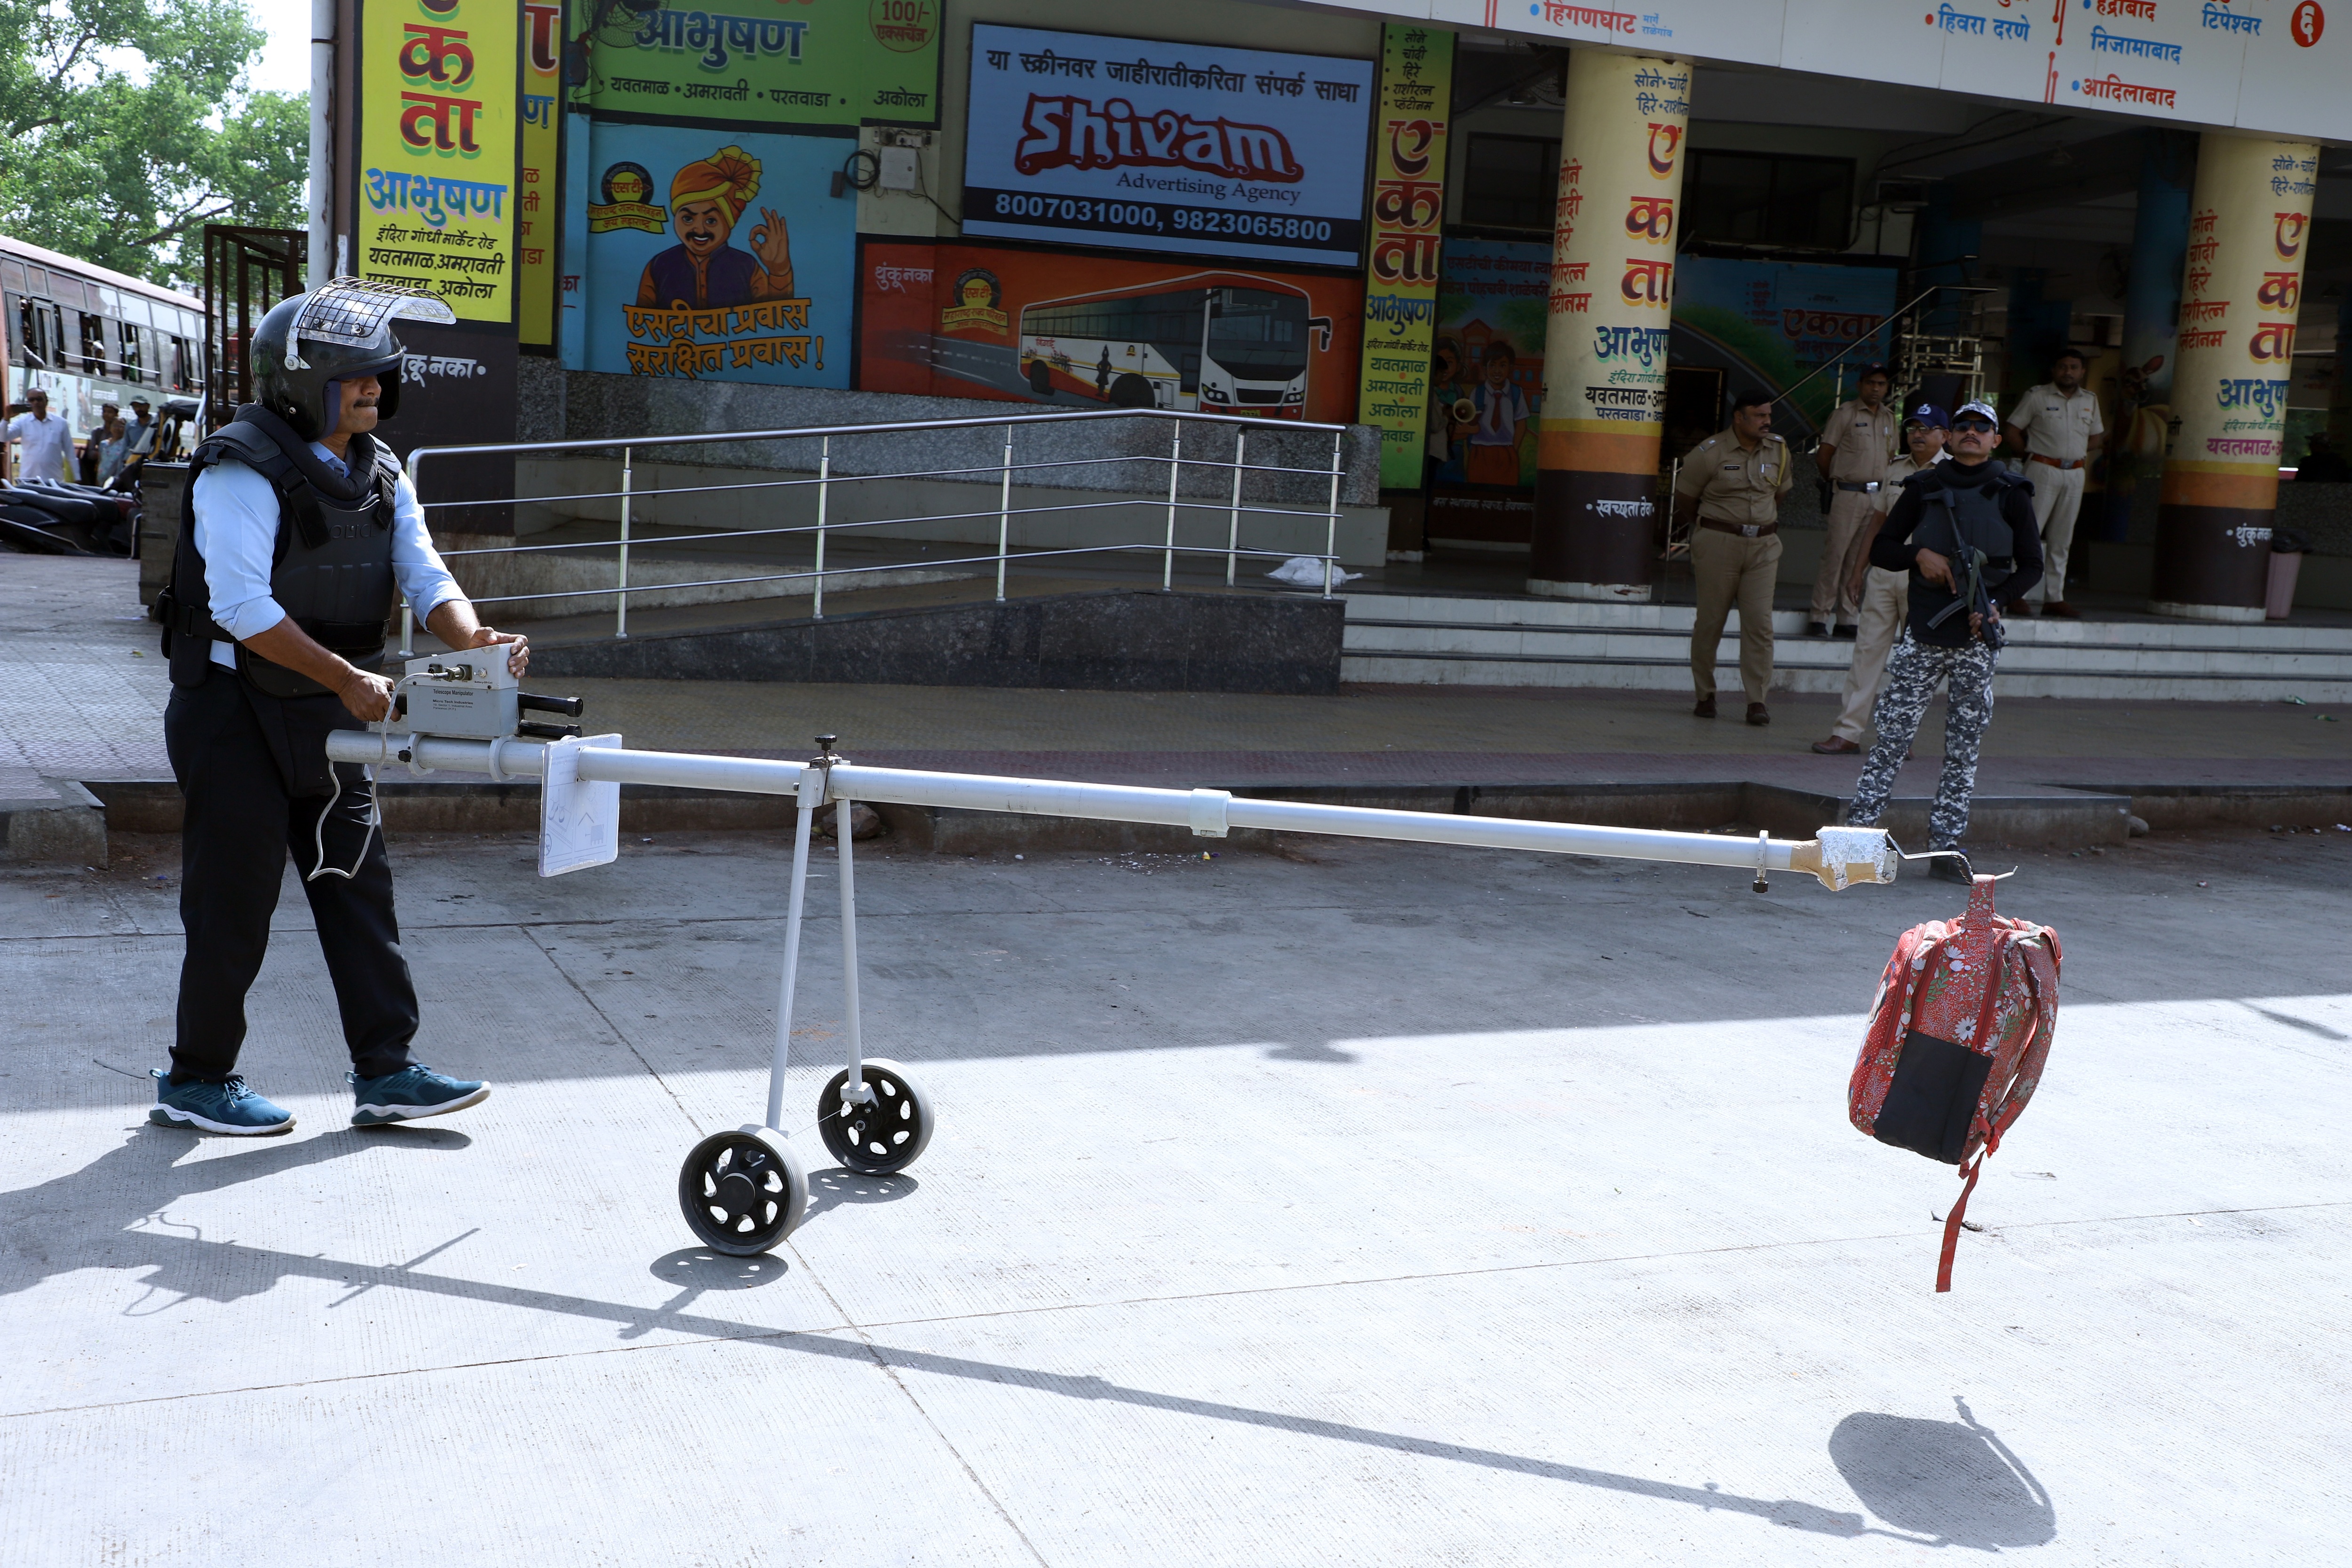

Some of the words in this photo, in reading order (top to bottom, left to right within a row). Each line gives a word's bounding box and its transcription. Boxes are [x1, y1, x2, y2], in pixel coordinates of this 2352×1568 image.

[1938, 3, 1986, 35] हिवरा
[1993, 14, 2031, 42] दरणे
[2202, 2, 2262, 36] टिपेश्वर
[1405, 29, 1428, 43] सोने
[2091, 25, 2182, 65] निजामाबाद
[1403, 46, 1427, 60] चांदी
[987, 50, 1010, 71] या
[1105, 58, 1246, 93] जाहीरातीकरिता
[1255, 70, 1306, 97] संपर्क
[1314, 79, 1360, 103] साधा
[1403, 62, 1422, 80] हिरे
[1634, 68, 1661, 88] सोने
[611, 77, 669, 96] यवतमाळ
[683, 79, 749, 102] अमरावती
[770, 89, 831, 107] परतवाडा
[874, 87, 927, 108] अकोला
[2082, 74, 2176, 109] आदिलाबाद
[1636, 93, 1658, 115] हिरे
[1014, 93, 1305, 183] Shivam
[2272, 155, 2295, 171] सोने
[1116, 172, 1226, 199] Advertising
[1232, 183, 1301, 206] Agency
[2271, 176, 2288, 196] हिरे
[365, 167, 508, 228] आभुषण
[996, 193, 1164, 231] 8007031000,
[1173, 210, 1331, 241] 9823065800
[376, 223, 409, 243] इंदिरा
[411, 228, 442, 243] गांधी
[443, 230, 477, 247] मार्केट
[477, 232, 497, 249] रोड
[437, 276, 497, 299] अकोला
[623, 298, 728, 341] एसटीचा
[731, 297, 811, 334] प्रवास
[1367, 294, 1435, 335] आभुषण
[627, 338, 726, 380] सुरक्षित
[729, 335, 810, 370] प्रवास
[1371, 358, 1428, 373] यवतमाळ
[1366, 378, 1424, 395] अमरावती
[1608, 369, 1637, 384] इंदिरा
[1585, 387, 1647, 406] यवतमाळ
[1369, 399, 1421, 418] अकोला
[1596, 407, 1645, 421] परतवाडा
[1382, 430, 1415, 442] तवाडा
[2207, 438, 2272, 455] यवतमाळ
[329, 524, 378, 539] OLICE
